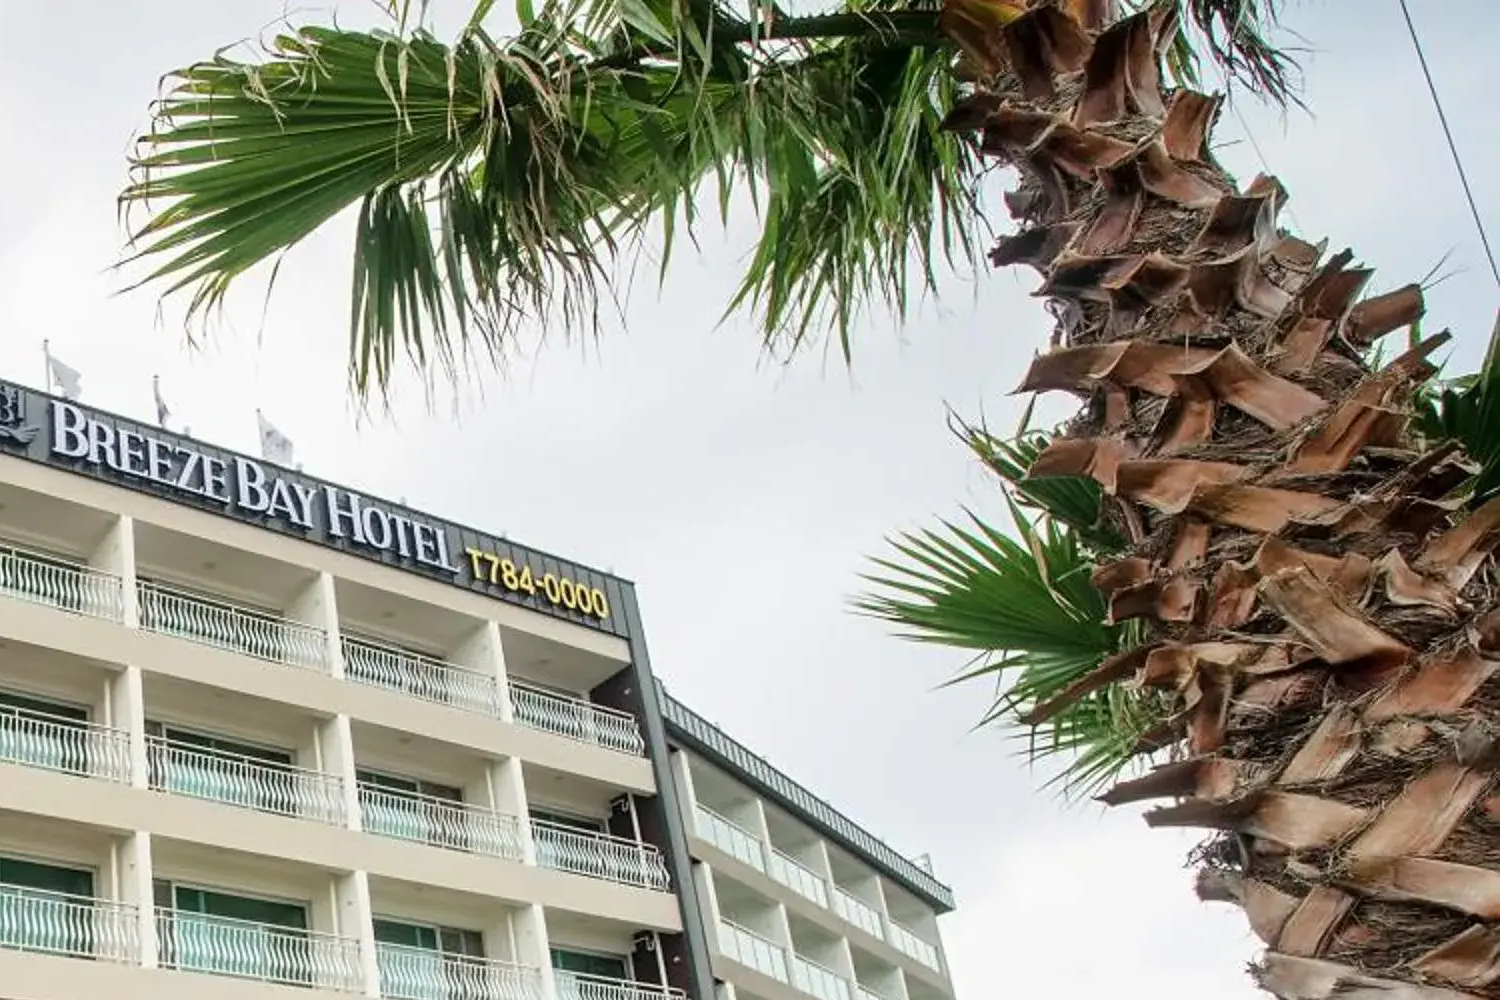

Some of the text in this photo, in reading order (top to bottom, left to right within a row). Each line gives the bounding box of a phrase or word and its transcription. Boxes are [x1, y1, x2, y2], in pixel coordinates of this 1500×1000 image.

[51, 400, 610, 620] BREEZE BAY HOTEL T784-0000
